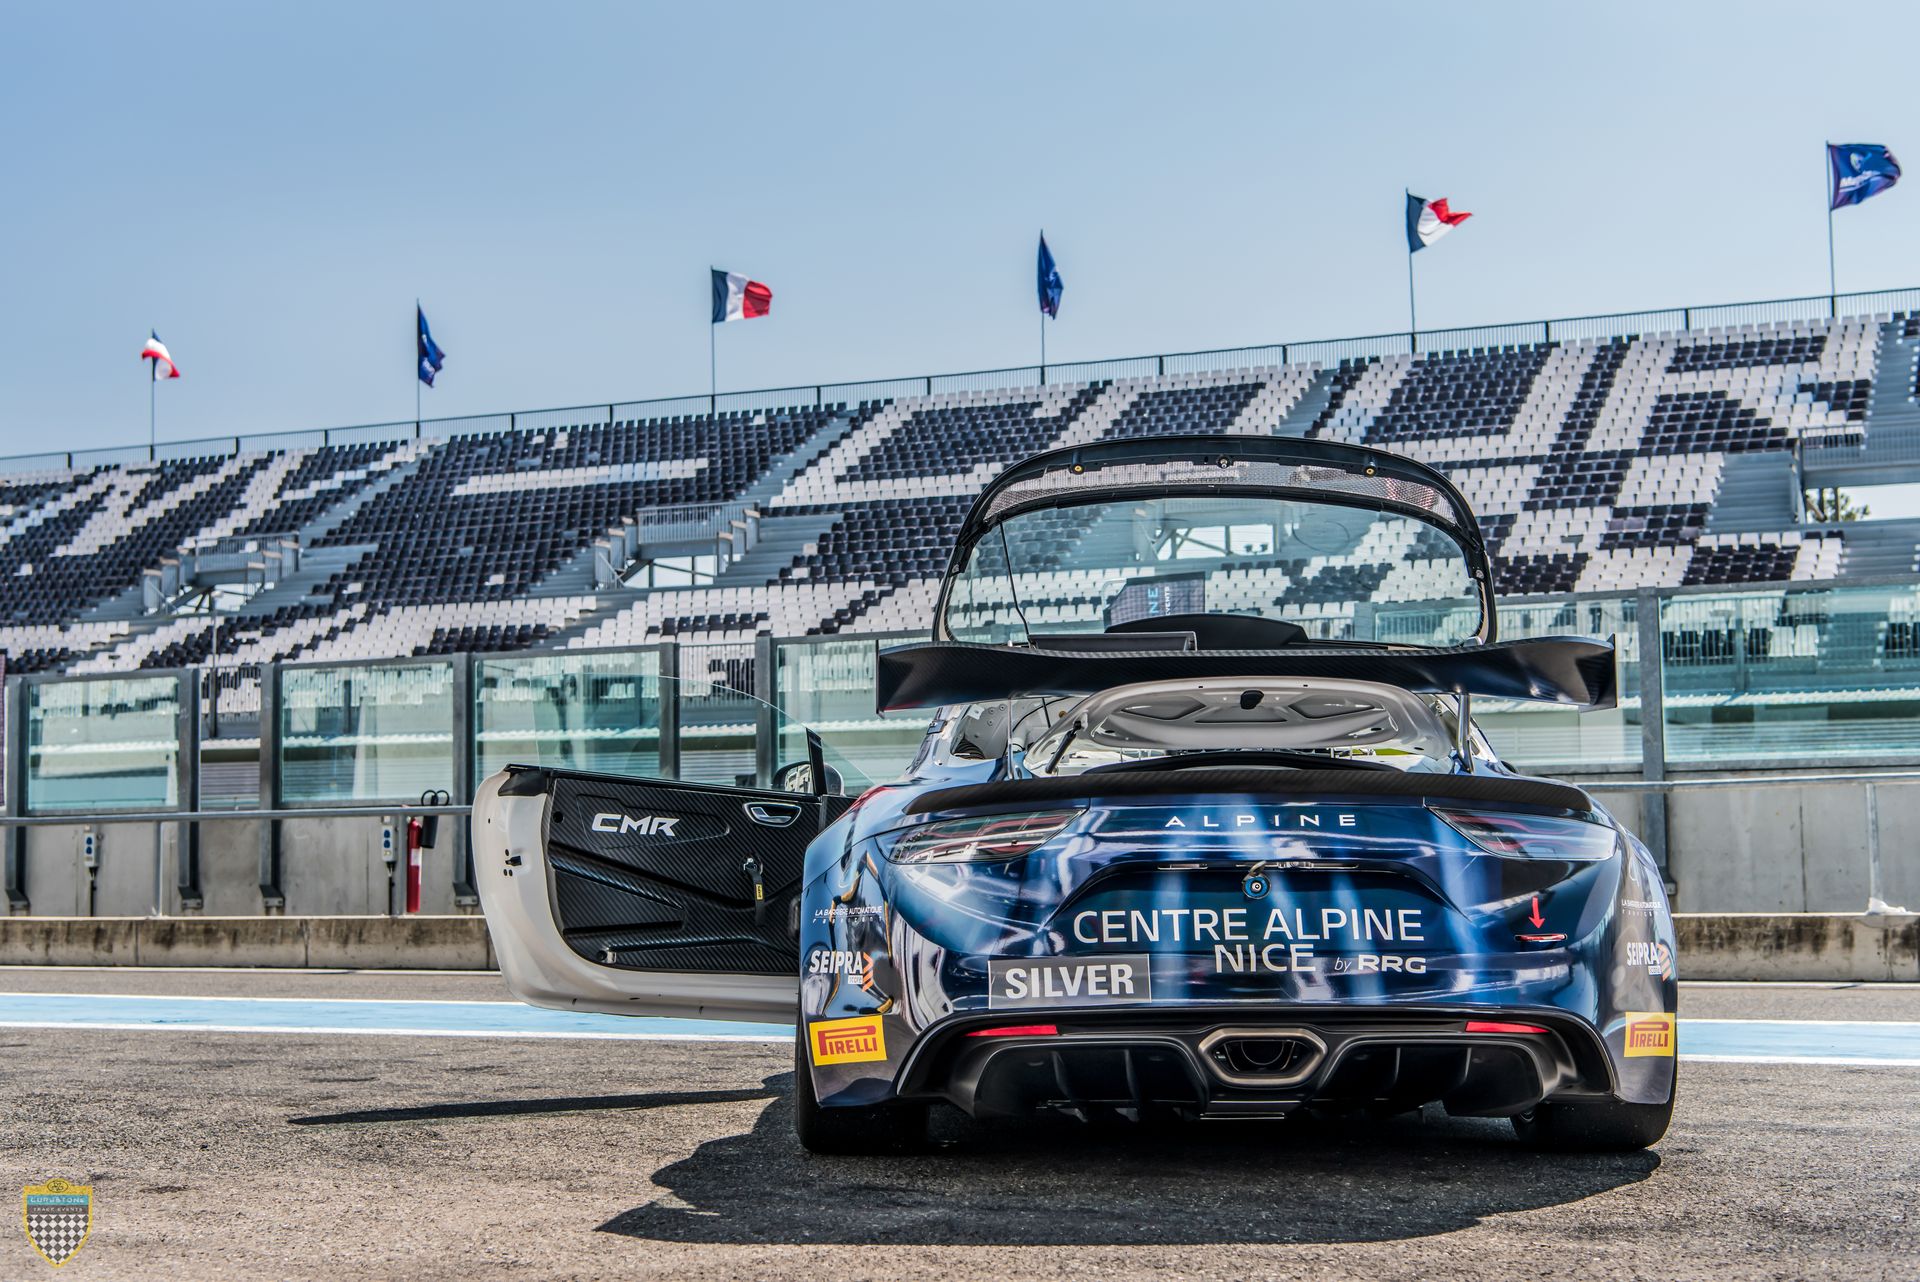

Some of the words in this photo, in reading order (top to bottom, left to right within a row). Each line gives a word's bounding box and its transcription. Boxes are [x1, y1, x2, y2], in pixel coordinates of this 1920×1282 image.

[591, 812, 681, 837] CMR
[1165, 813, 1356, 828] ALPINE
[1072, 907, 1250, 944] CENTRE
[1263, 907, 1426, 943] ALPINE
[809, 950, 863, 974] SEIPRA
[1213, 943, 1317, 974] NICE
[1333, 957, 1352, 973] by
[1357, 954, 1428, 974] RRG
[1626, 942, 1660, 966] SEIPRA
[1005, 963, 1135, 1000] SILVER
[817, 1024, 878, 1057] PIRELLI
[1629, 1021, 1669, 1048] PIRELLI
